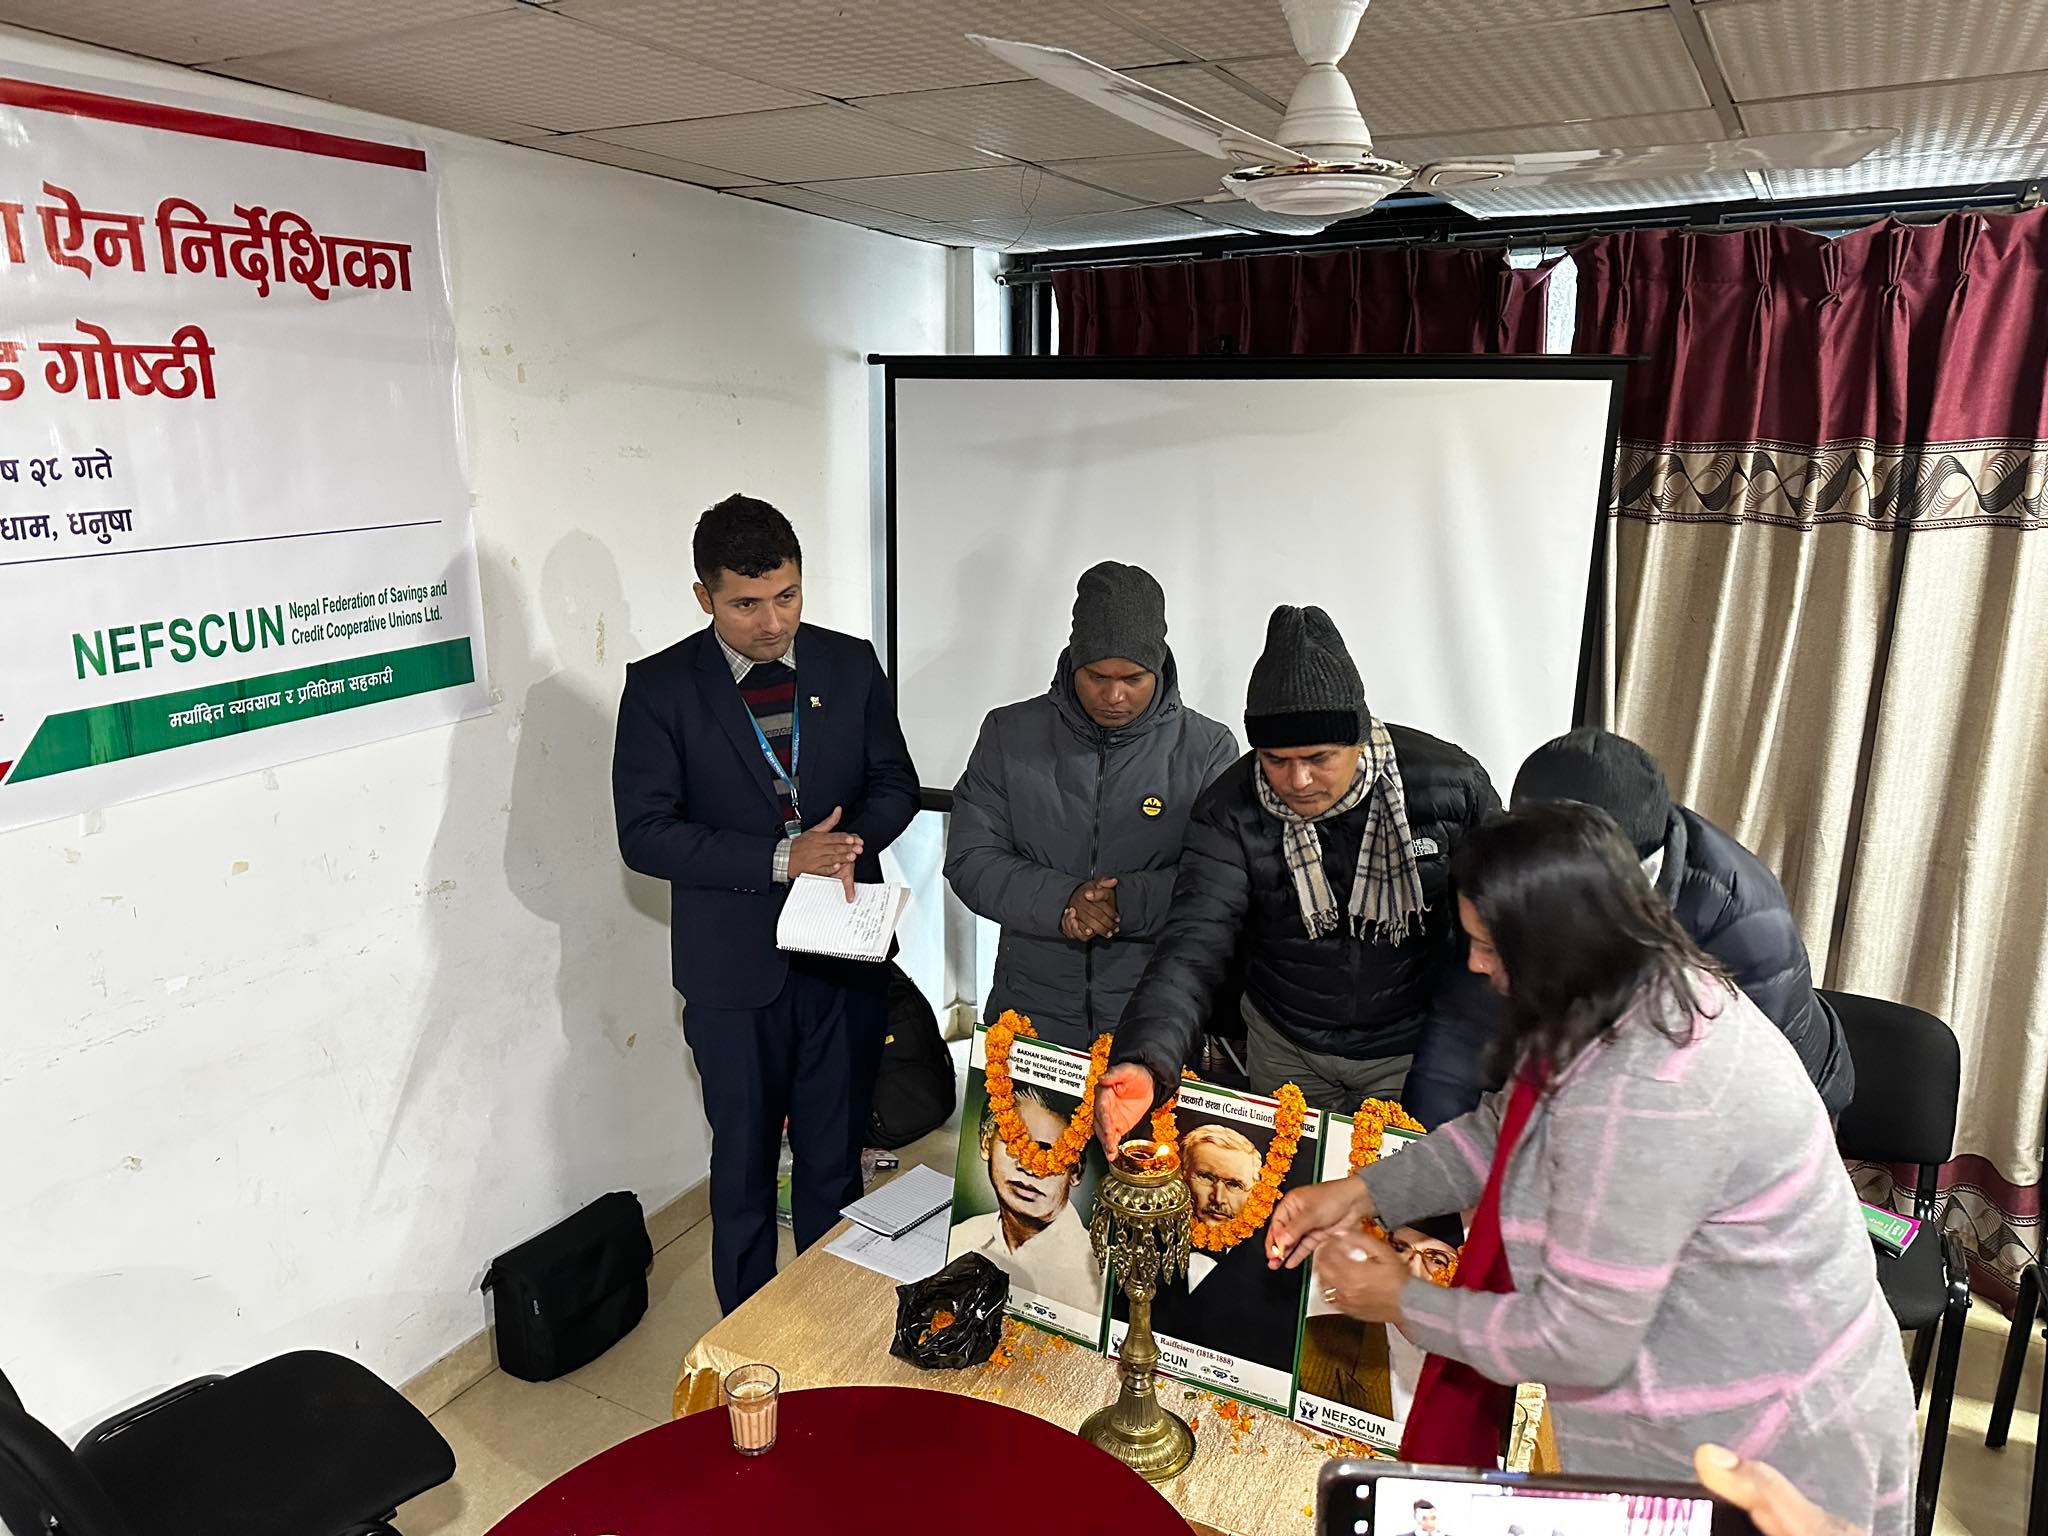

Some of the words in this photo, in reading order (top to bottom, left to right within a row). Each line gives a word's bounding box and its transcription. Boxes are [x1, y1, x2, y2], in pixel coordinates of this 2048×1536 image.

[36, 180, 145, 280] ऐन
[155, 197, 412, 301] निर्देशिका
[38, 318, 216, 400] गोष्ठी
[29, 457, 62, 487] २८
[72, 447, 113, 480] गते
[66, 508, 132, 544] धनुषा
[289, 598, 320, 621] Nepal
[323, 590, 376, 614] Federation
[377, 588, 389, 606] of
[389, 583, 428, 603] Savings
[430, 579, 448, 599] and
[72, 604, 285, 679] NEFSCUN
[291, 624, 325, 645] Credit
[326, 615, 387, 639] Cooperative
[388, 609, 423, 629] Unions
[424, 605, 443, 623] Ltd.
[168, 702, 224, 728] मर्यादित
[228, 691, 281, 715] व्यवसाय
[285, 689, 294, 704] र
[297, 679, 345, 705] प्रविधिमा
[348, 665, 393, 692] सहकारी
[1008, 1055, 1024, 1065] NDER
[1032, 1062, 1058, 1074] NEPALESE
[1058, 1068, 1088, 1081] CO-OPERA
[1016, 1048, 1040, 1060] BAKHAN
[1040, 1055, 1058, 1064] SINGH
[1057, 1059, 1083, 1071] GURUNG
[1222, 1102, 1248, 1118] (Credit
[1160, 1337, 1195, 1354] Raiffeisen
[1322, 1406, 1386, 1437] NEFSCUN
